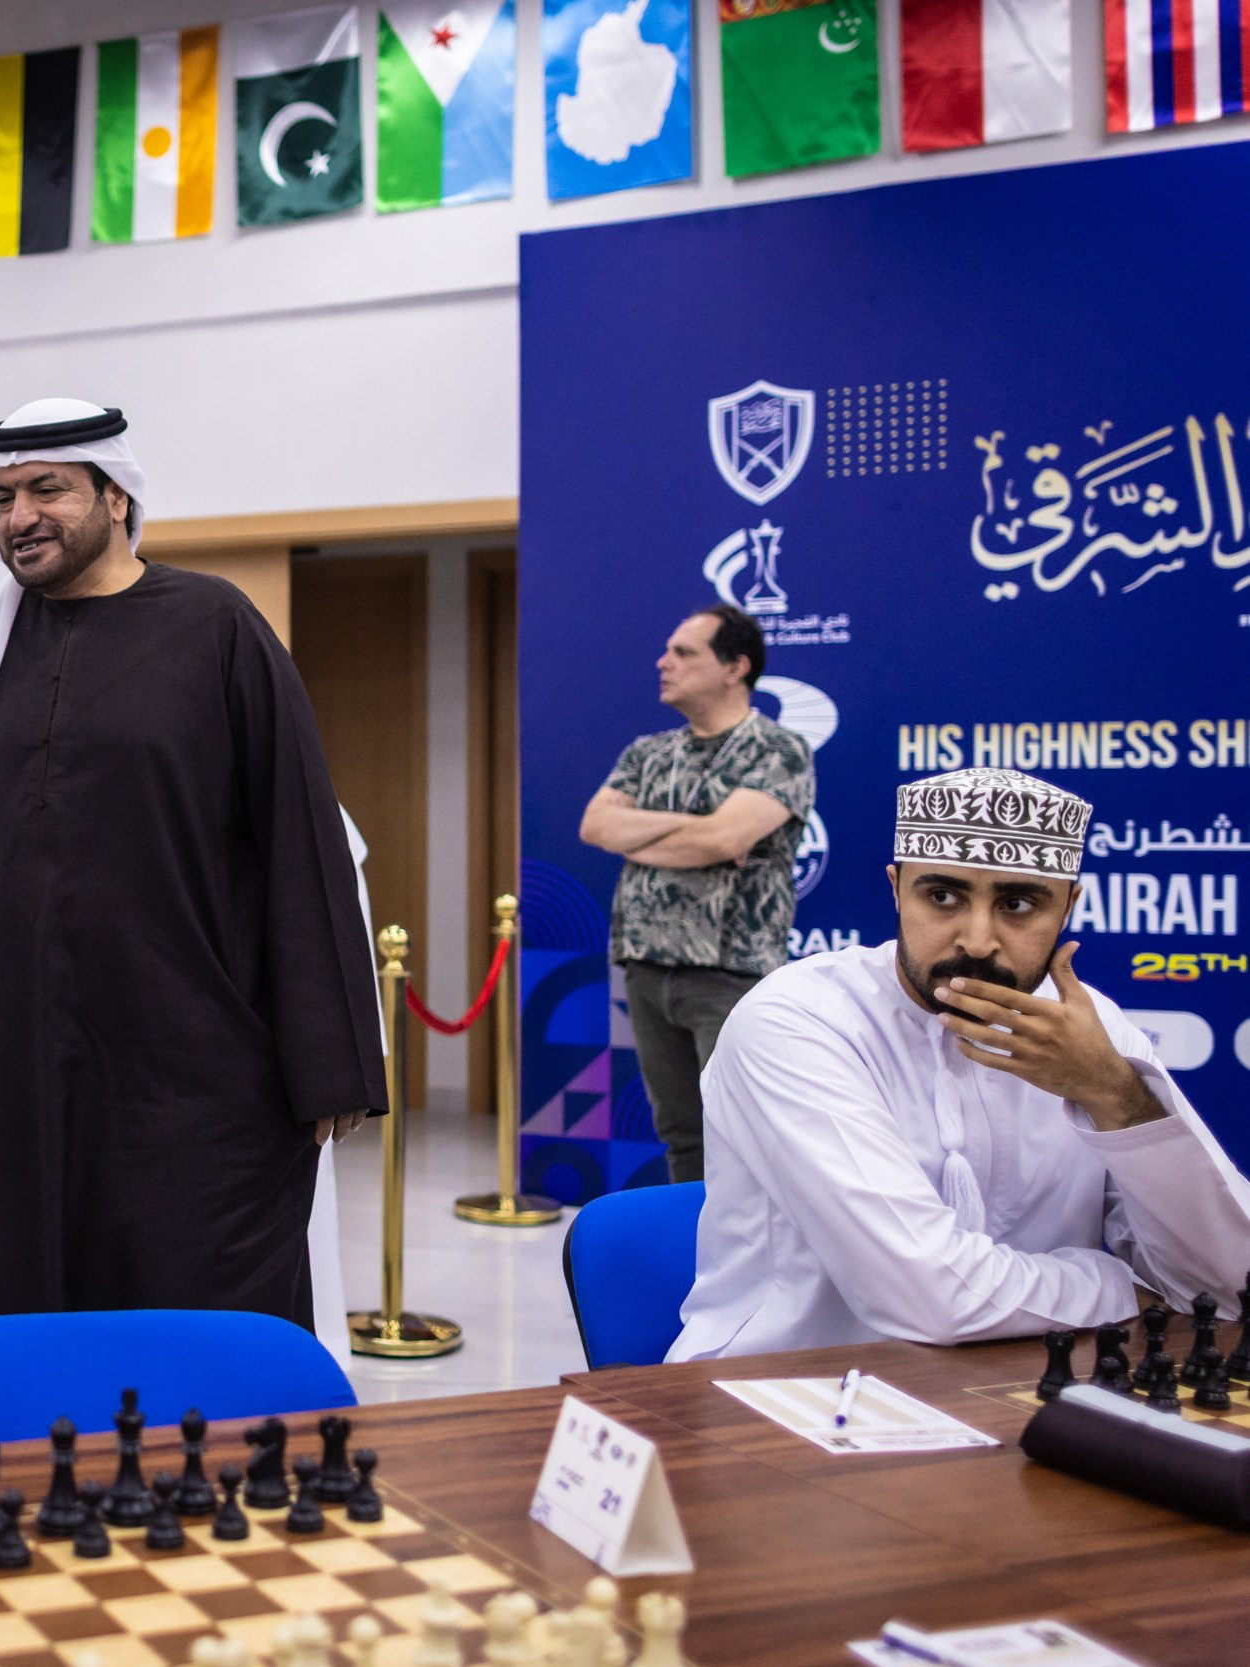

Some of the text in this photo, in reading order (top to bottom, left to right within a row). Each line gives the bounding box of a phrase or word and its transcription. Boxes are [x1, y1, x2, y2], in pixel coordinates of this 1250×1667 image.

[898, 720, 1250, 771] HIS HIGHNESS SH
[1088, 813, 1250, 858] شطرنج
[1131, 952, 1248, 982] 25TH
